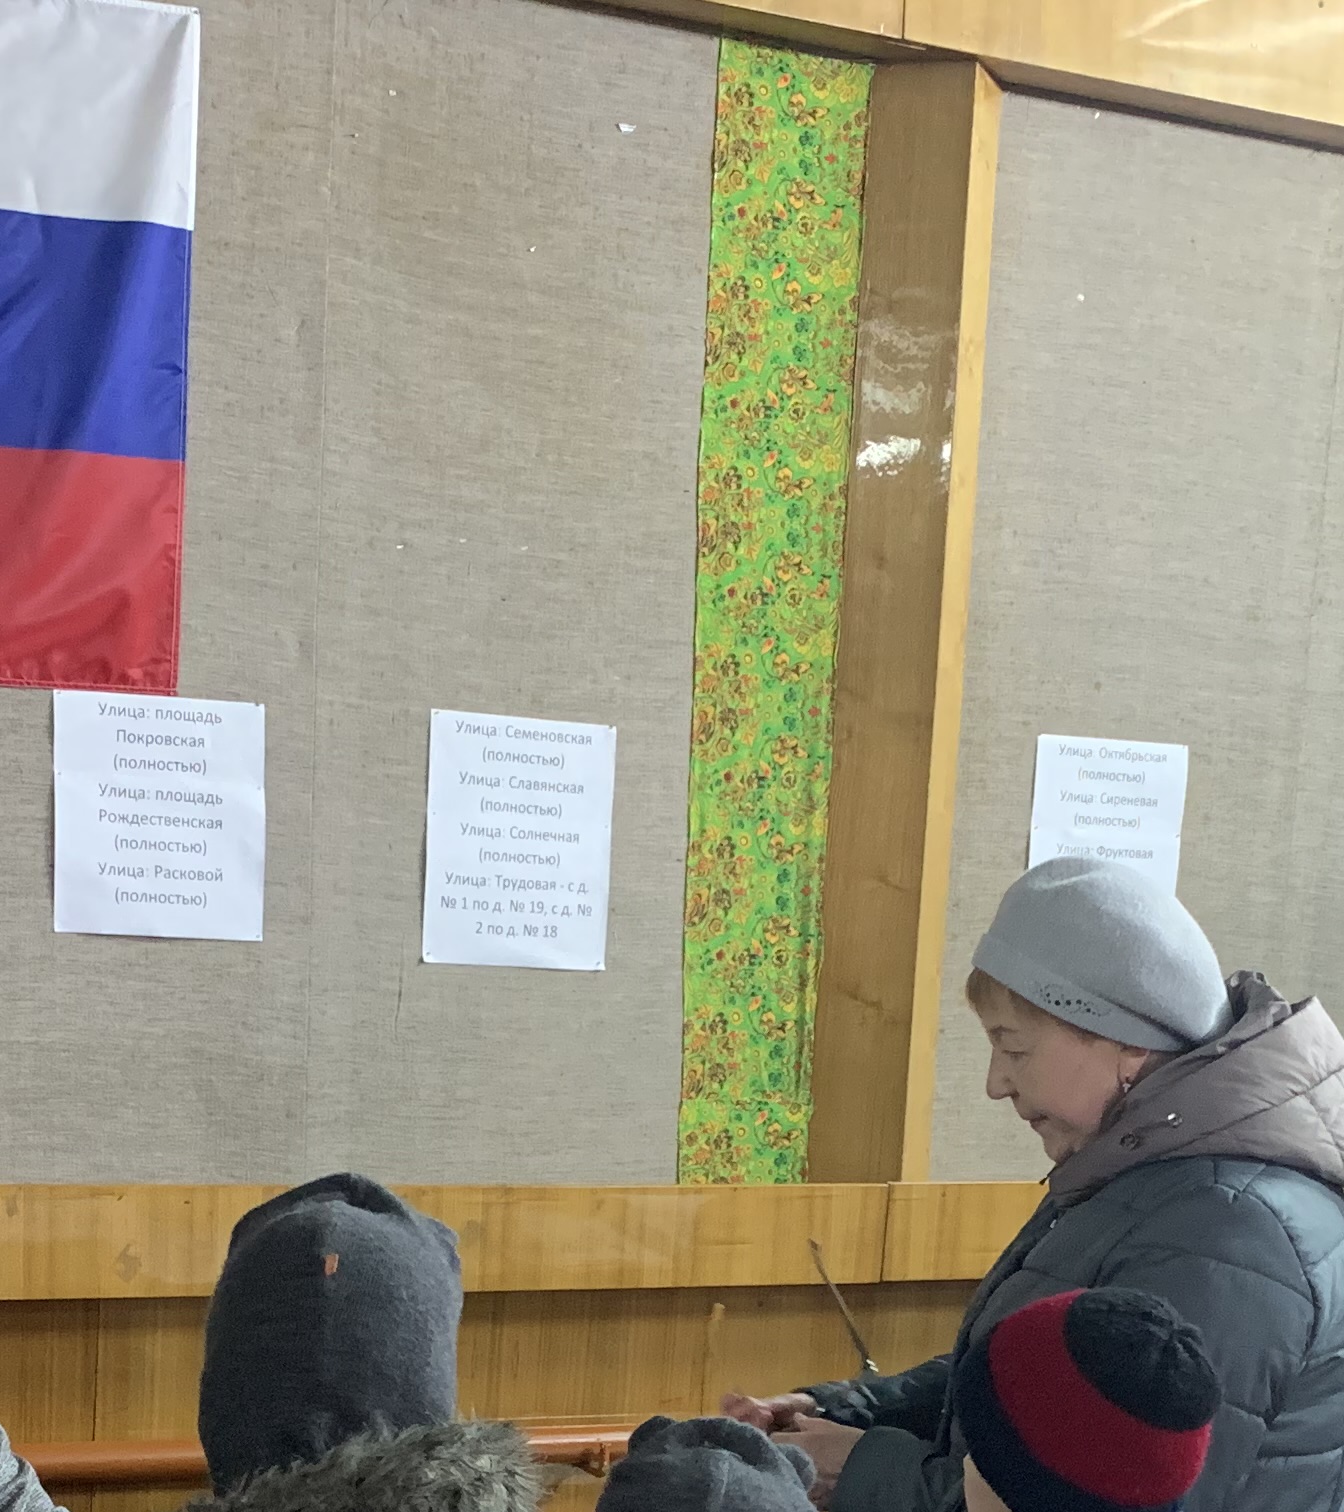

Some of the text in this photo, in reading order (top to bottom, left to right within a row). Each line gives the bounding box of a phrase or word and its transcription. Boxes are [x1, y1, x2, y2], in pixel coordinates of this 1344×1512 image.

[98, 702, 223, 725] Улица: площадь
[116, 729, 205, 748] Покровская
[505, 725, 592, 746] Семеновская
[113, 754, 207, 775] (полностью)
[482, 747, 565, 769] (полностью)
[98, 783, 223, 806] Улица: площадь
[508, 776, 584, 795] Славянская
[480, 797, 562, 818] (полностью)
[99, 809, 223, 830] Рождественская
[114, 834, 207, 856] (полностью)
[509, 826, 580, 844] Солнечная
[479, 848, 561, 867] (полностью)
[98, 862, 224, 882] Улица: Расковой
[495, 875, 556, 891] Трудовая
[568, 882, 574, 892] с
[577, 882, 589, 894] д.
[115, 888, 207, 908] (полностью)
[441, 896, 592, 917] № 1 по д. № 19, с д. №
[475, 922, 558, 937] 2 по д. № 18
